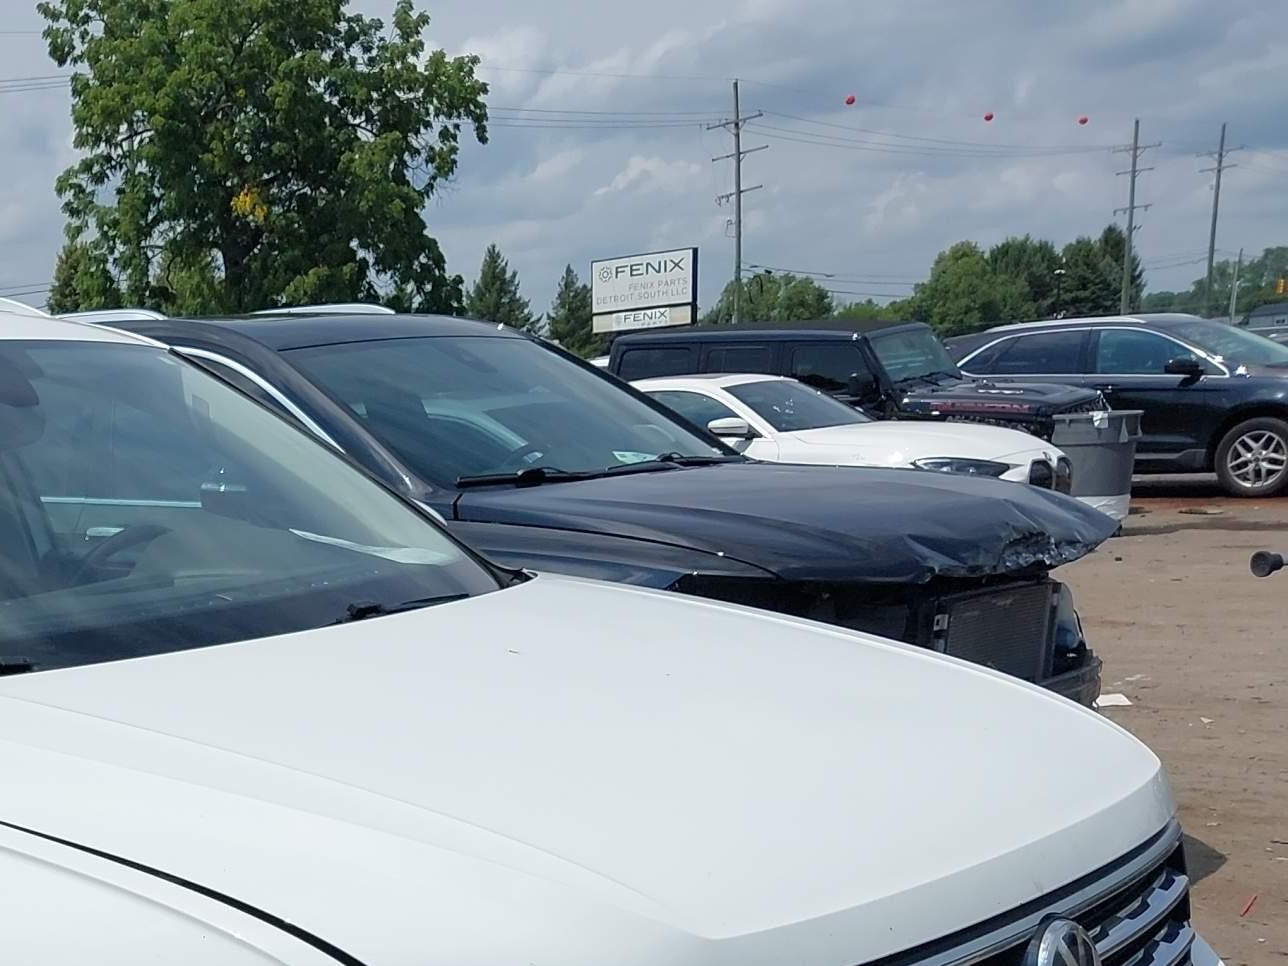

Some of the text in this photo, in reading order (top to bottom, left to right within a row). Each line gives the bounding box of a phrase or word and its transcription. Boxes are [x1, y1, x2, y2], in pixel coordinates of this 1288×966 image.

[615, 257, 684, 279] FENIX
[628, 277, 687, 291] FENIX PARTS
[596, 286, 688, 305] DETROIT SOUTH LLC
[623, 310, 668, 323] FENIX
